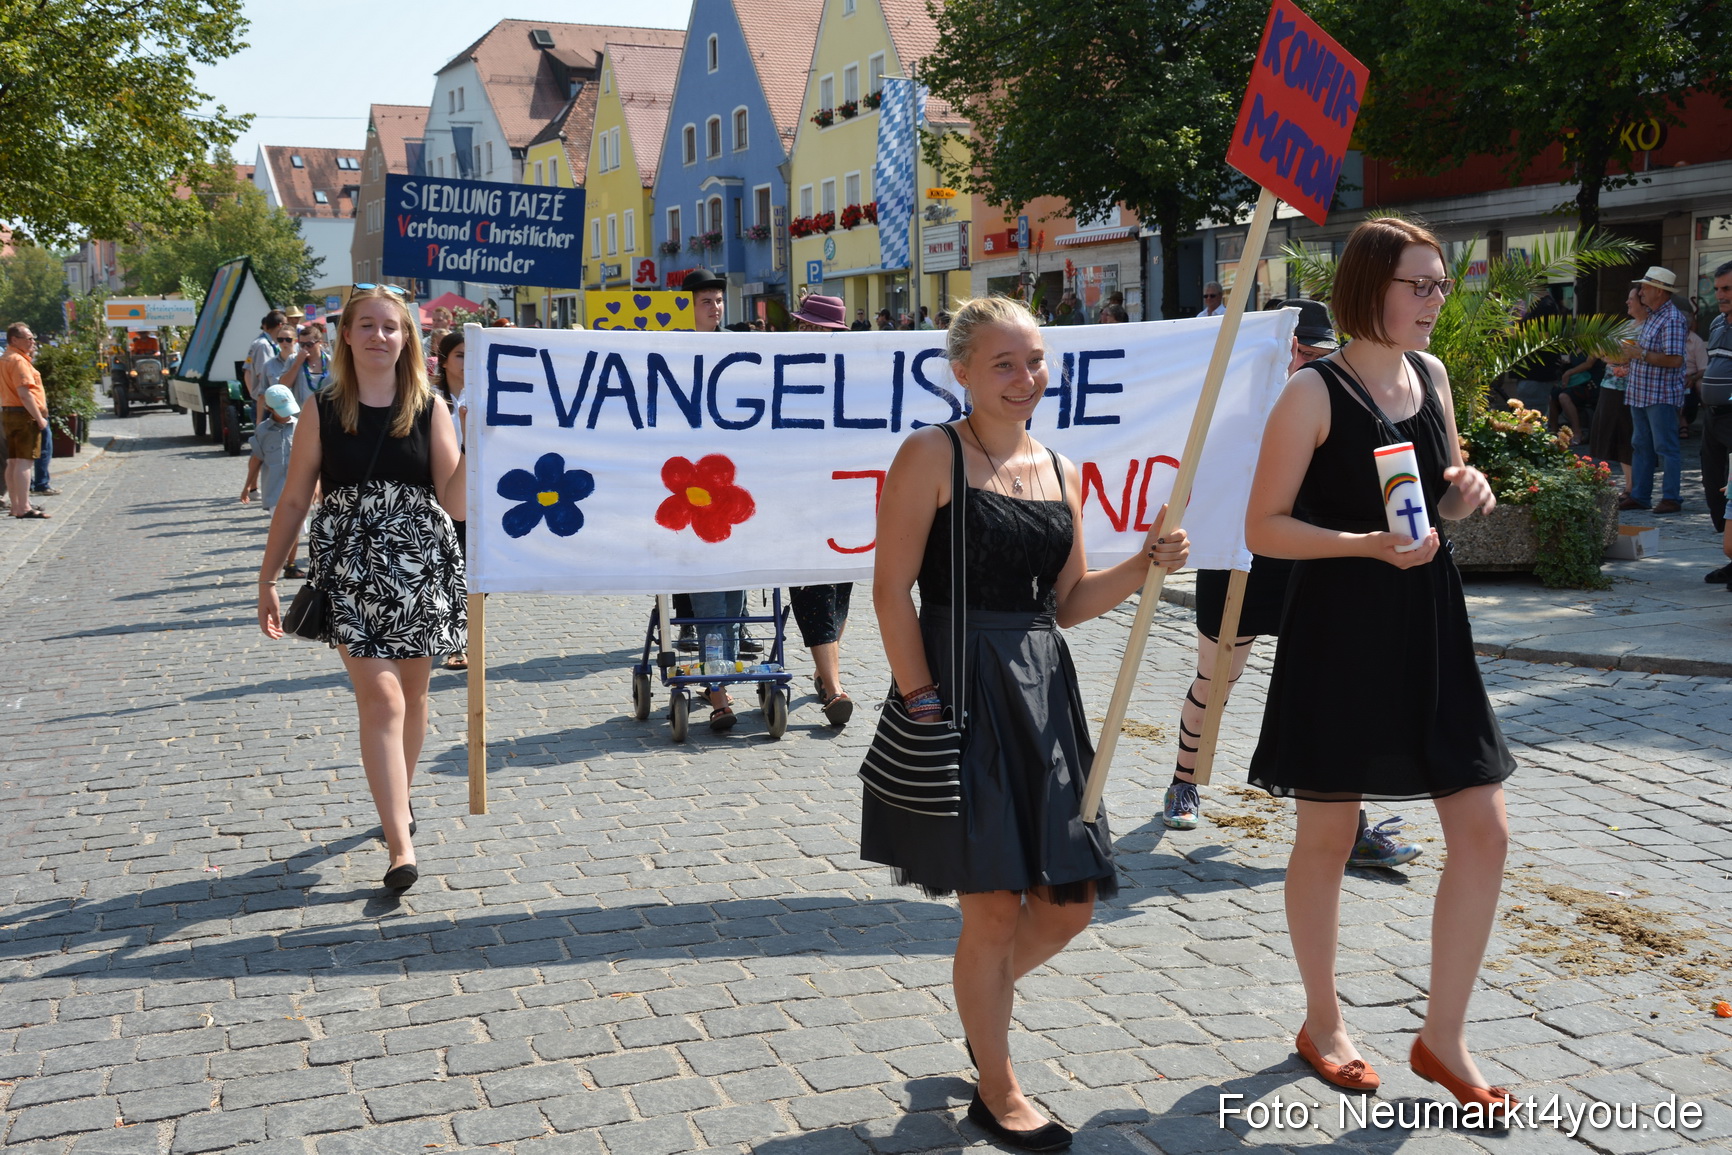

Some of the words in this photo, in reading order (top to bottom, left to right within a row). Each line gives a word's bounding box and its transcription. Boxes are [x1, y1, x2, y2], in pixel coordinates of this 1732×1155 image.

[1242, 92, 1342, 211] MATION
[397, 214, 471, 241] Verband
[475, 220, 575, 249] Christlicher
[400, 181, 502, 217] SIEDLUNG
[508, 189, 567, 222] TAIZÉ
[426, 243, 535, 275] Pfadfinder
[486, 343, 1126, 433] EVANGELISHE
[826, 454, 1192, 555] JND
